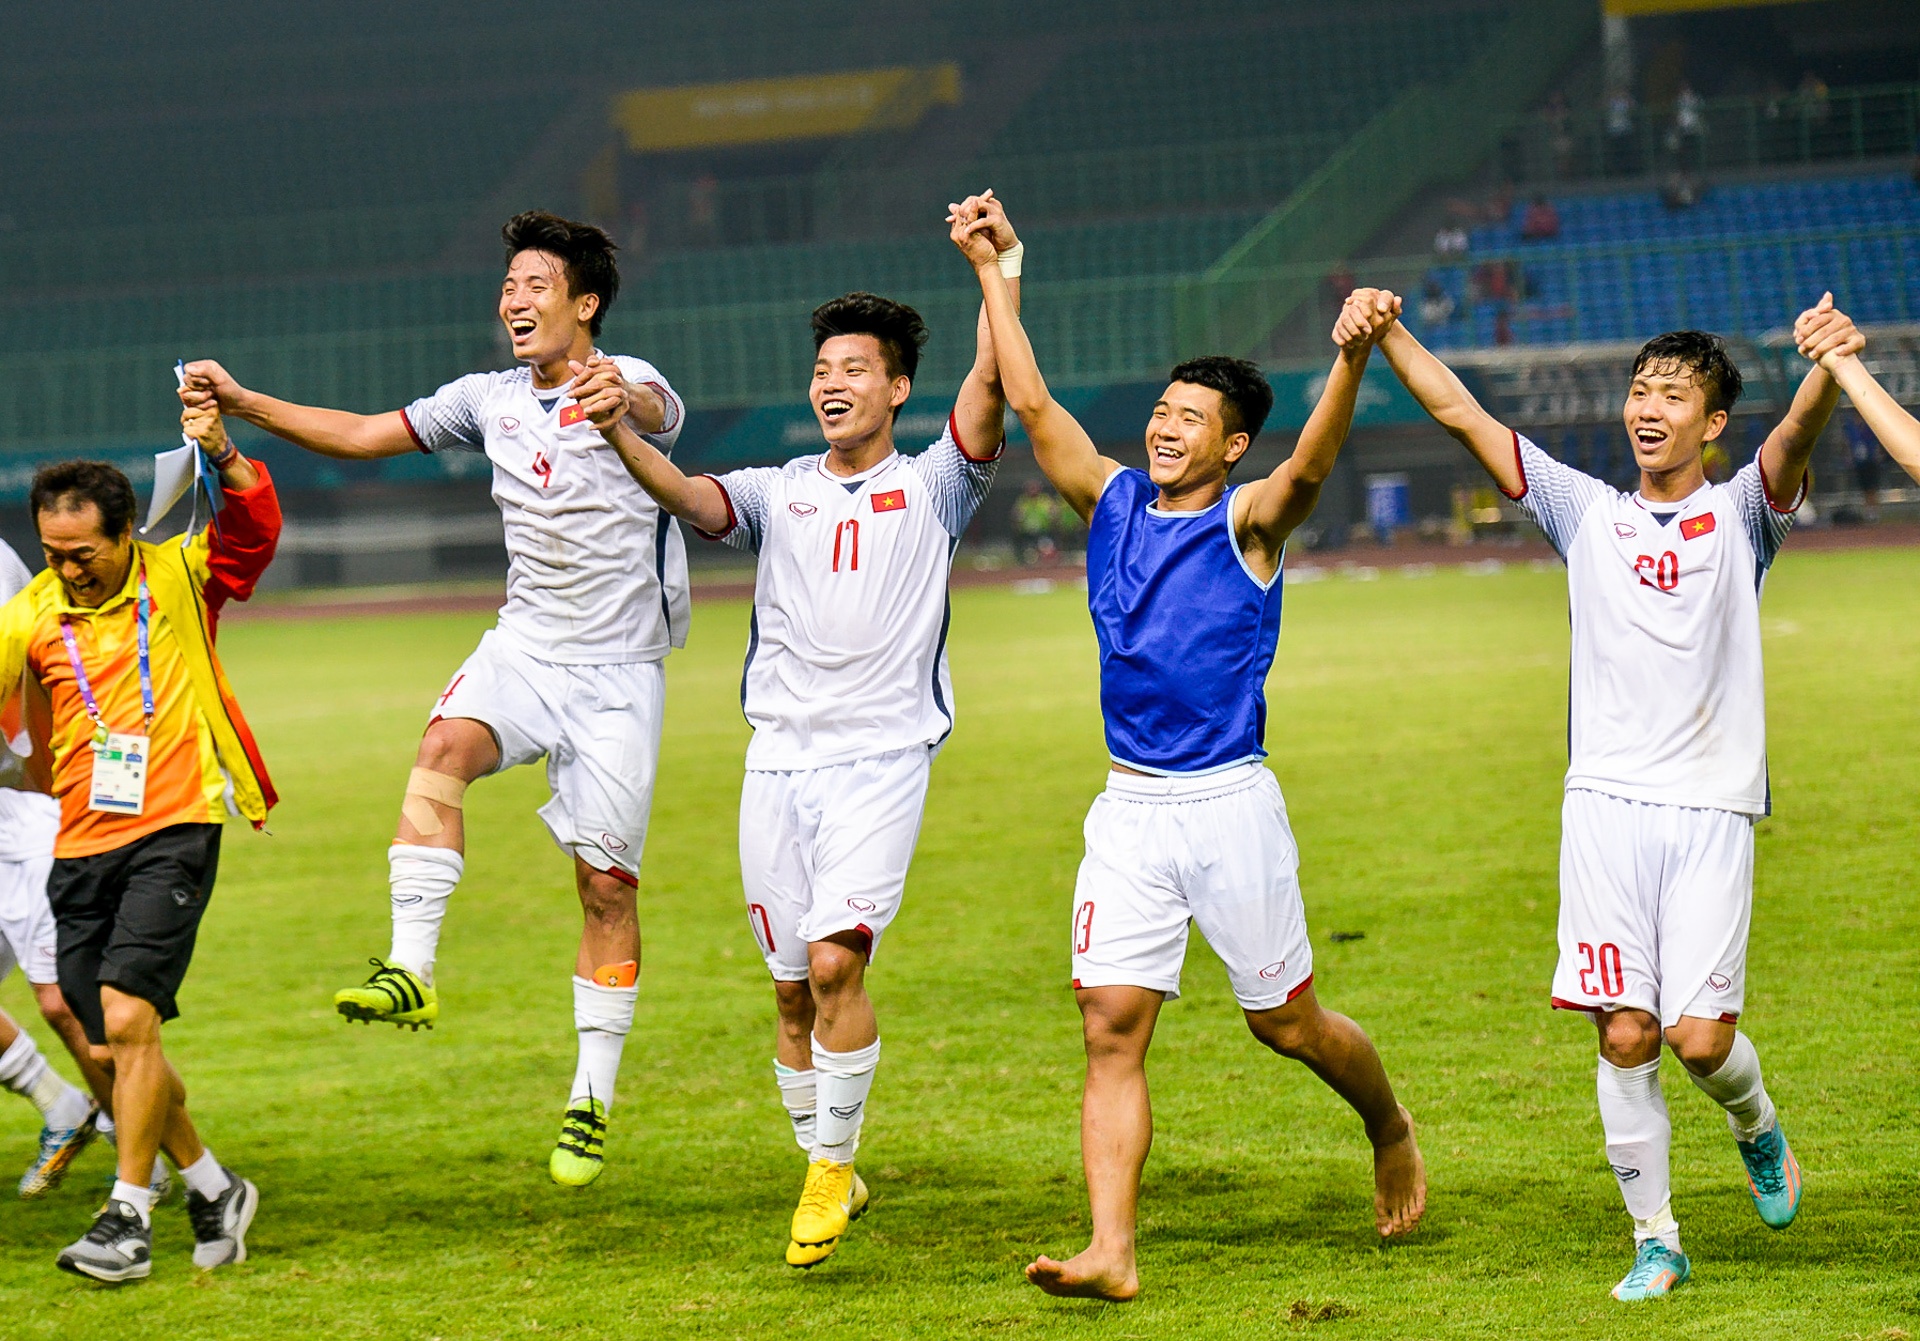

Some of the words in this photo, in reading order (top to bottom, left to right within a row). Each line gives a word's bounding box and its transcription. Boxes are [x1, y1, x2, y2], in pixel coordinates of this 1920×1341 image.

[532, 452, 552, 488] 4
[832, 519, 859, 573] 17
[1634, 550, 1679, 591] 20
[1073, 901, 1095, 955] 13
[1578, 942, 1625, 998] 20
